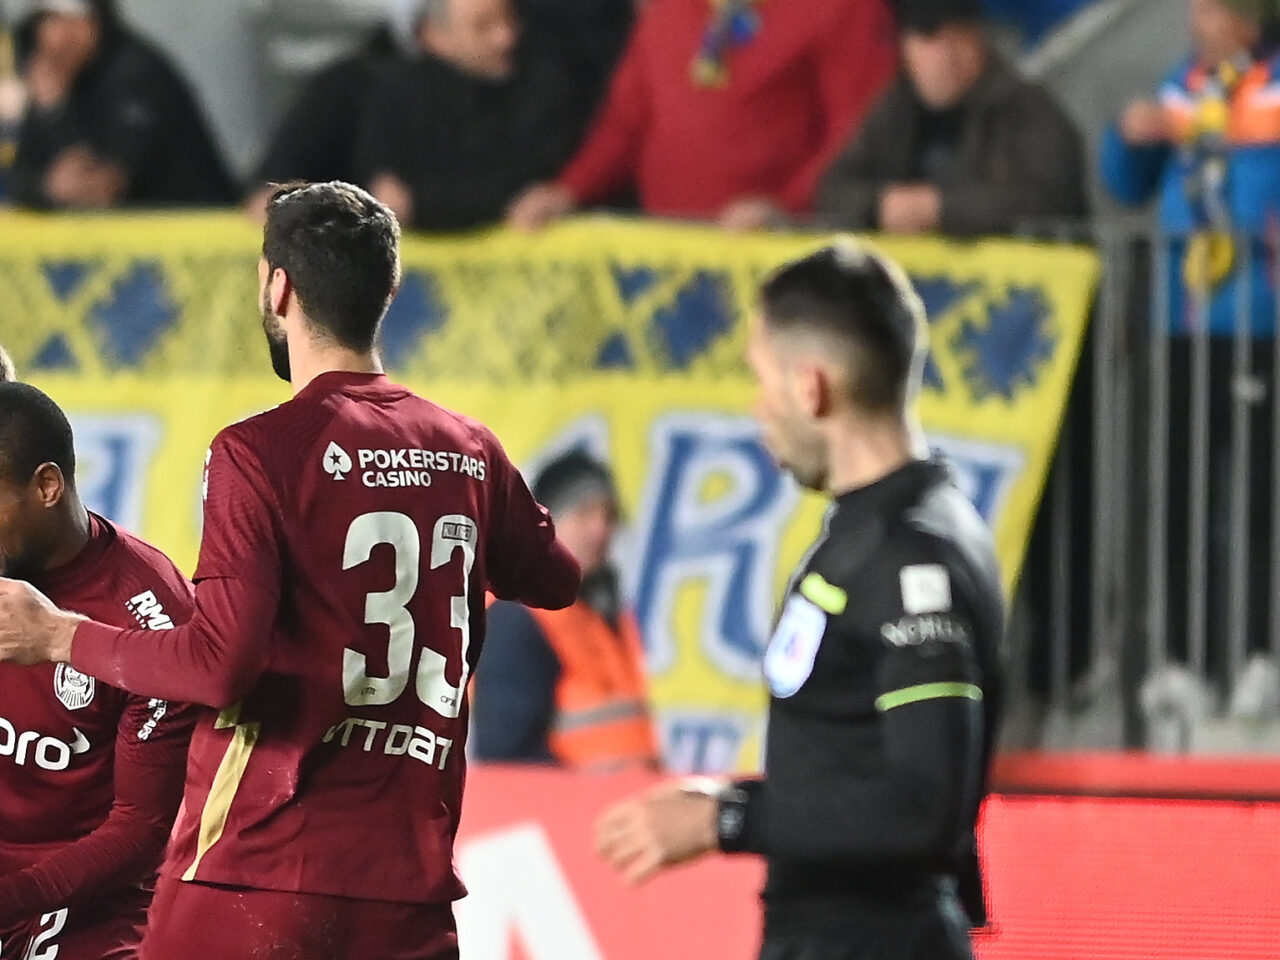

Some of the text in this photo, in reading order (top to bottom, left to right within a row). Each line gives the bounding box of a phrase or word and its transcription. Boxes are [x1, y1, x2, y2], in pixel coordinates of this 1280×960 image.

[358, 448, 486, 481] POKERSTARS
[362, 470, 432, 487] CASINO
[341, 510, 478, 718] 33
